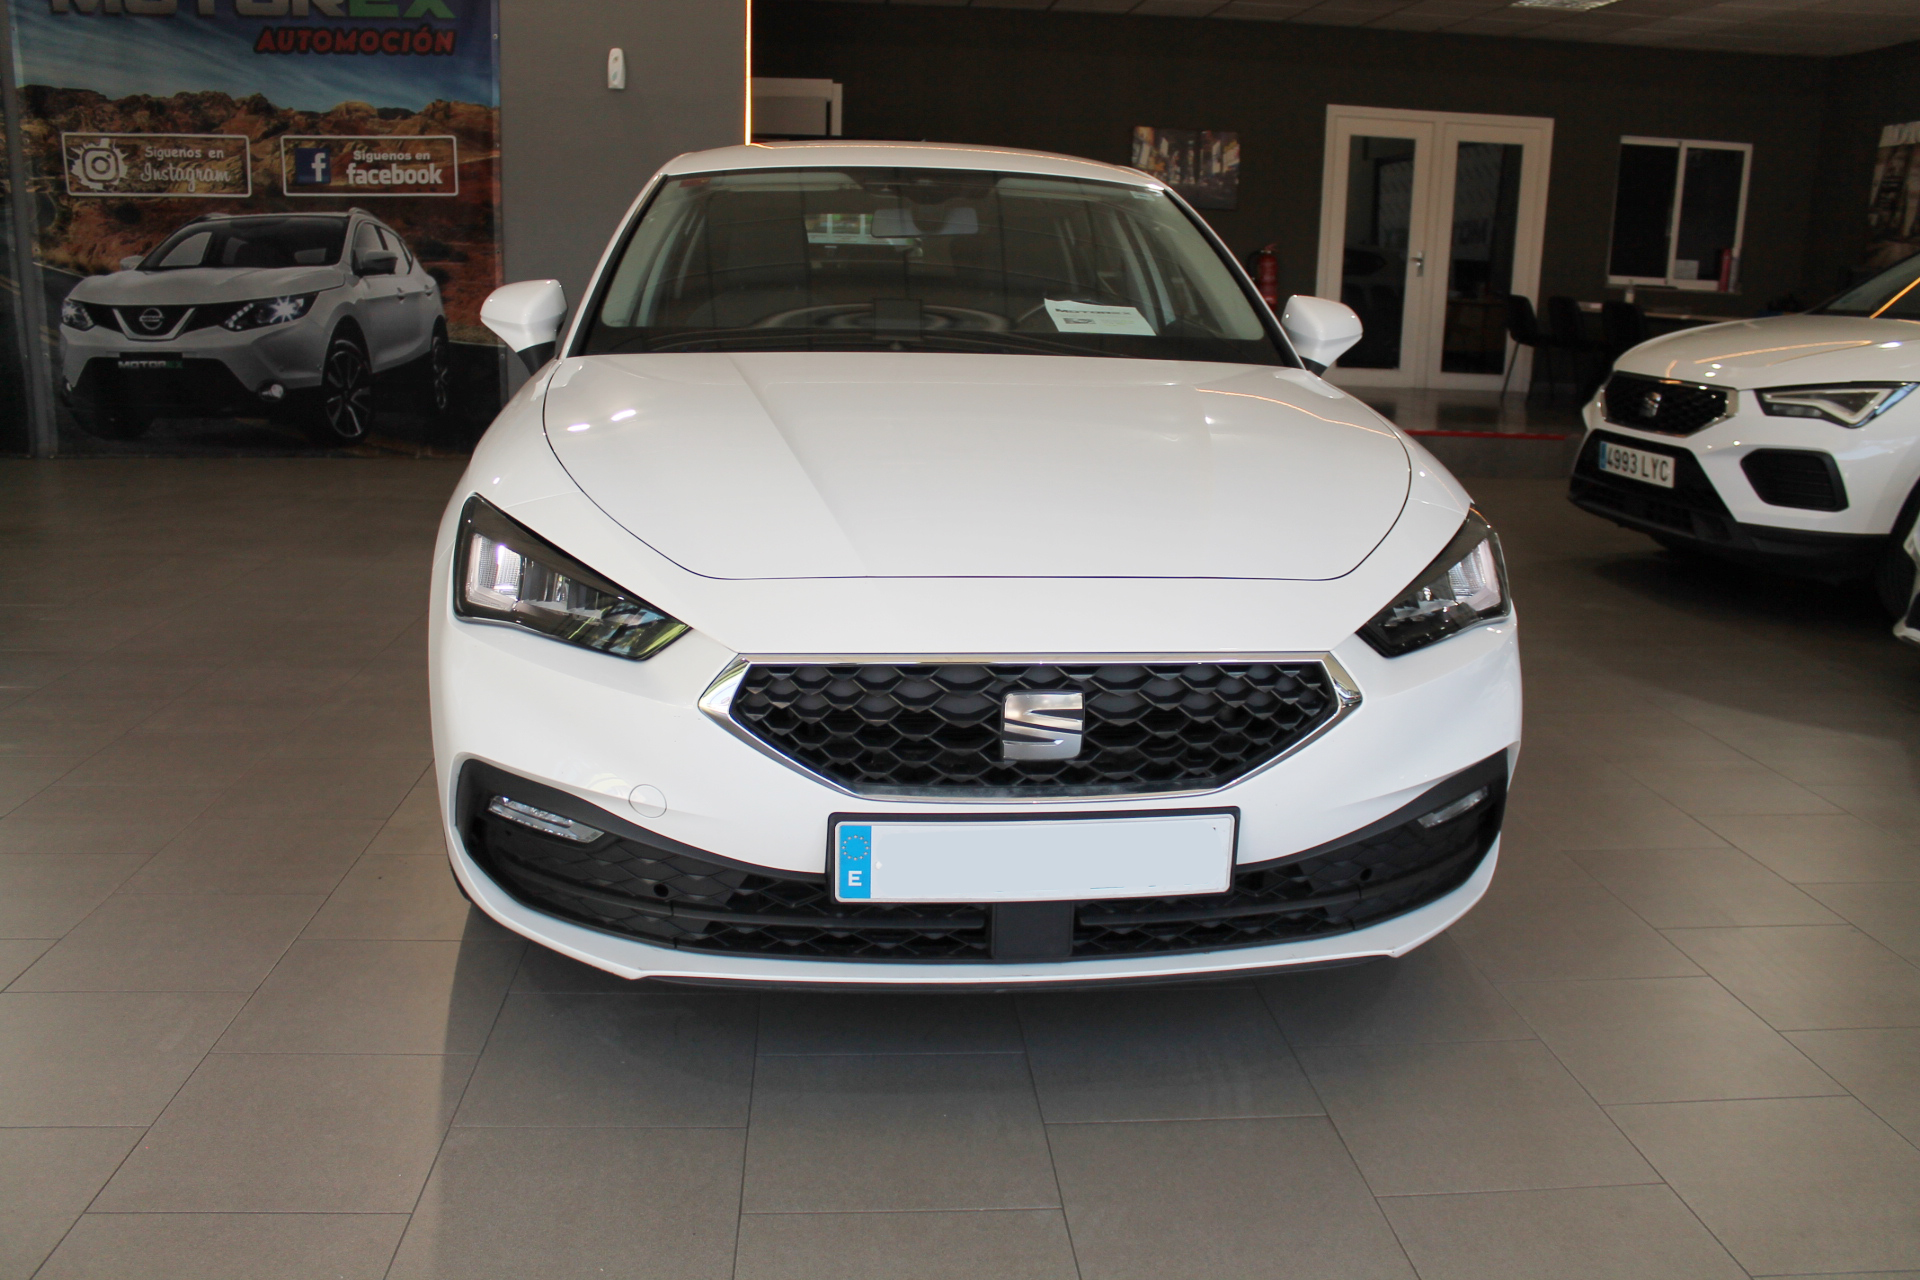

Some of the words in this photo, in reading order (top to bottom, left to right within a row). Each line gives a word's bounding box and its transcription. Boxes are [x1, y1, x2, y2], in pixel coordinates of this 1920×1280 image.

[256, 27, 455, 53] AUTOMOCIÓN
[208, 150, 224, 158] en
[415, 152, 431, 160] en
[140, 163, 231, 192] Instagram
[346, 163, 443, 185] facebook
[1607, 448, 1637, 474] 4993
[1641, 456, 1668, 481] LYC
[848, 870, 862, 887] E
